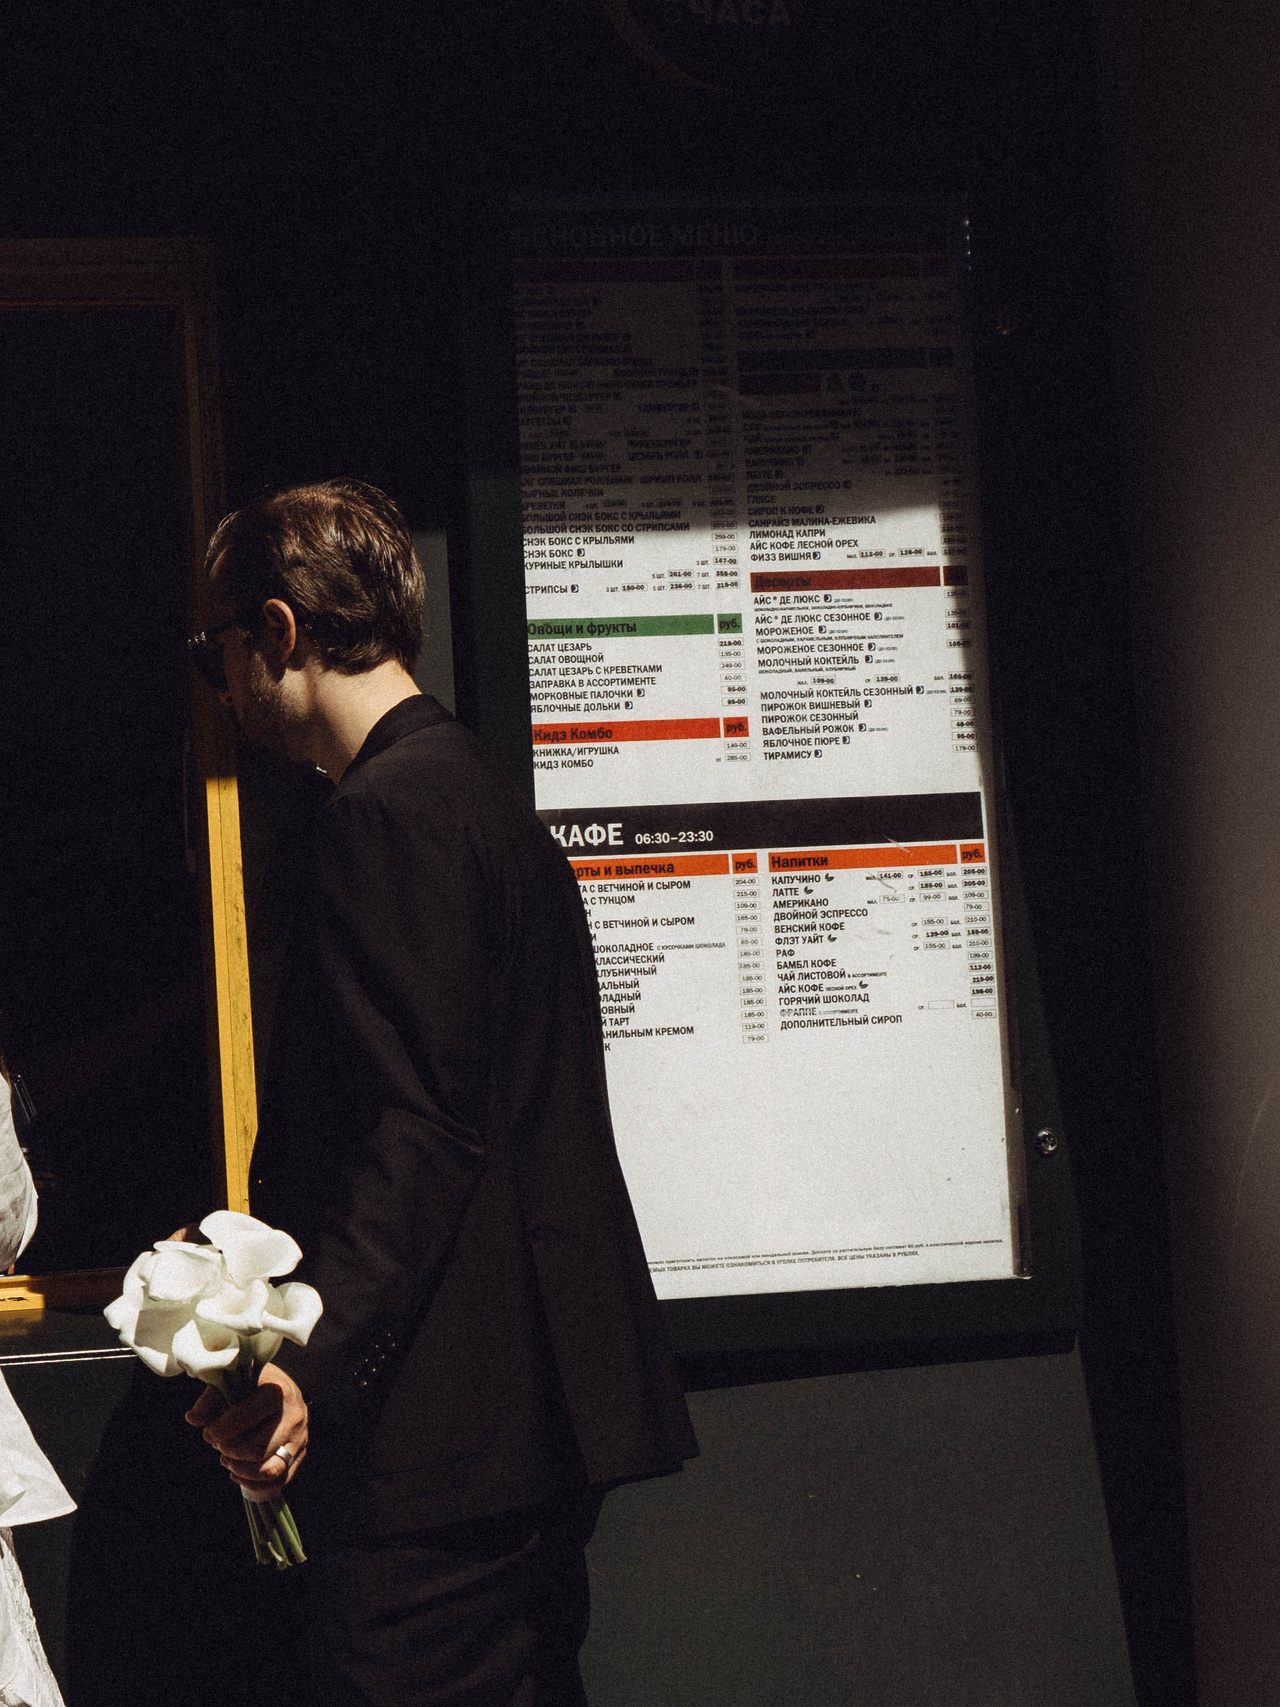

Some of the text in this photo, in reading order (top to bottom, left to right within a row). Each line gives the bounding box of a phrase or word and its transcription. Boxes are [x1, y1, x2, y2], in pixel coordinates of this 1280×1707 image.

[748, 516, 790, 527] САНРАЙЗ
[792, 515, 876, 527] МАЛИНА-ЕЖЕВИКА
[569, 524, 593, 534] СНЭК
[595, 523, 620, 533] БОКС
[621, 523, 634, 532] СО
[636, 522, 690, 532] СТРИПСАМИ
[749, 528, 826, 540] ЛИМОНАД КАПРИ
[523, 535, 635, 547] СНЭК БОКС С КРЫЛЬЯМИ
[750, 538, 859, 550] АЙС КОФЕ ЛЕСНОЙ ОРЕХ
[523, 548, 573, 559] СНЭК БОКС
[750, 551, 812, 562] ФИЗЗ ВИШНЯ
[524, 559, 623, 570] КУРИНЫЕ КРЫЛЫШКИ
[525, 585, 568, 595] СТРИПСЫ
[779, 595, 791, 606] ДЕ
[793, 594, 820, 604] ЛЮКС
[780, 615, 793, 625] ДЕ
[794, 614, 822, 624] ЛЮКС
[823, 612, 871, 623] СЕЗОННОЕ
[527, 617, 741, 637] Овощи и фрукты руб.
[755, 626, 814, 637] МОРОЖЕНОЕ
[528, 642, 592, 654] САЛАТ ЦЕЗАРЬ
[756, 642, 864, 655] МОРОЖЕНОЕ СЕЗОННОЕ
[528, 652, 604, 665] САЛАТ ОВОЩНОЙ
[757, 653, 860, 667] МОЛОЧНЫЙ КОКТЕЙЛЬ
[529, 664, 663, 678] САЛАТ ЦЕЗАРЬ С КРЕВЕТКАМИ
[529, 676, 656, 689] ЗАПРАВКА В АССОРТИМЕНТЕ
[530, 689, 633, 702] МОРКОВНЫЕ ПАЛОЧКИ
[760, 684, 914, 700] МОЛОЧНЫЙ КОКТЕЙЛЬ СЕЗОННЫЙ
[531, 701, 621, 714] ЯБЛОЧНЫЕ ДОЛЬКИ
[761, 699, 861, 713] ПИРОЖОК ВИШНЕВЫЙ
[761, 711, 859, 725] ПИРОЖОК СЕЗОННЫЙ
[533, 721, 747, 743] Кидз Комбо руб.
[762, 722, 855, 736] ВАФЕЛЬНЫЙ РОЖОК
[762, 736, 840, 748] ЯБЛОЧНОЕ ПЮРЕ
[533, 746, 620, 758] КНИЖКА/ИГРУШКА
[763, 749, 812, 761] ТИРАМИСУ
[534, 758, 594, 770] КИДЗ КОМБО
[550, 822, 623, 847] КАФЕ
[771, 847, 983, 869] Напитки руб.
[604, 858, 757, 877] и выпечка руб.
[771, 874, 821, 886] КАПУЧИНО
[589, 880, 691, 894] С ВЕТЧИНОЙ И СЫРОМ
[772, 887, 800, 898] ЛАТТЕ
[590, 895, 635, 906] С ТУНЦОМ
[772, 897, 829, 909] АМЕРИКАНО
[773, 908, 868, 922] ДВОЙНОЙ ЭСПРЕССО
[594, 916, 695, 930] С ВЕТЧИНОЙ И СЫРОМ
[774, 921, 845, 934] ВЕНСКИЙ КОФЕ
[775, 933, 824, 946] ФЛЭТ УАЙТ
[593, 942, 654, 954] ШОКОЛАДНОЕ
[775, 948, 795, 959] РАФ
[776, 958, 837, 970] БАМБЛ КОФЕ
[777, 970, 796, 982] ЧАЙ
[797, 969, 847, 981] ЛИСТОВОЙ
[778, 983, 797, 995] АЙС
[798, 983, 824, 993] КОФЕ
[778, 993, 870, 1006] ГОРЯЧИЙ ШОКОЛАД
[608, 1017, 630, 1027] ТАРТ
[780, 1014, 902, 1031] ДОПОЛНИТЕЛЬНЫЙ СИРОП
[654, 1026, 694, 1037] КРЕМОМ
